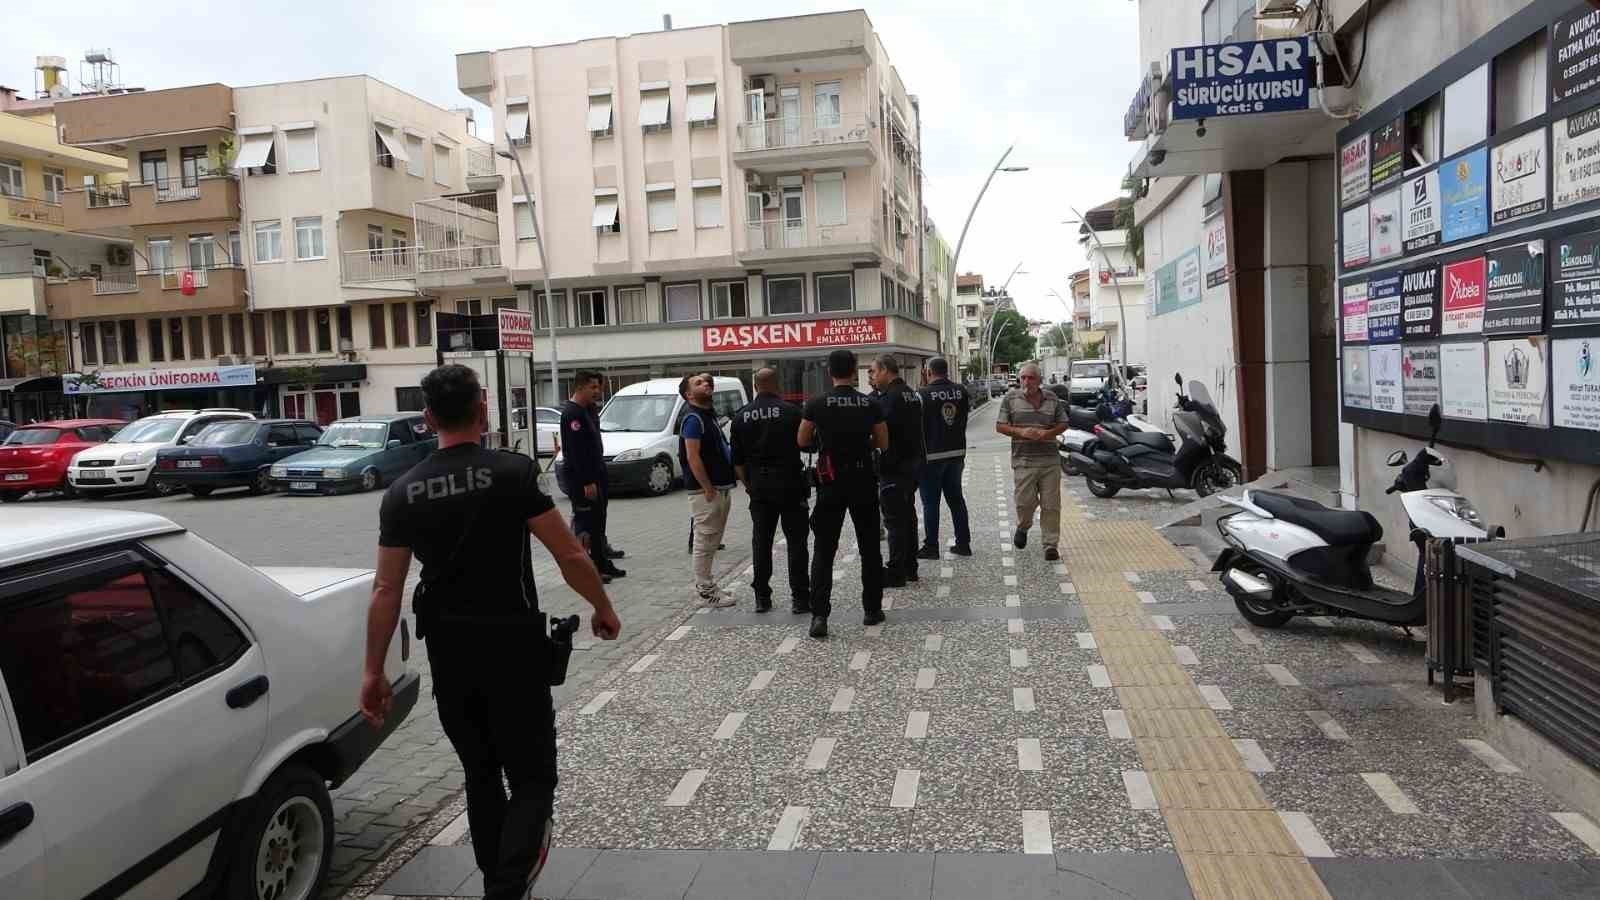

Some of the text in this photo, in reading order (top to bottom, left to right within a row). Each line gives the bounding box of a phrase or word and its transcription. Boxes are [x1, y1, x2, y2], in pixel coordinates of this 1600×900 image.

[1558, 39, 1583, 63] FATMA
[1177, 78, 1304, 106] SÜRÜCÜ KURSU
[1216, 101, 1265, 115] Kat: 6
[1403, 269, 1436, 293] AVUKAT
[500, 313, 533, 331] OTOPARK
[824, 325, 873, 335] RENT A CAR
[706, 322, 816, 347] BAŞKENT
[150, 370, 221, 387] ÜNİFORMA
[406, 465, 494, 504] POLİS
